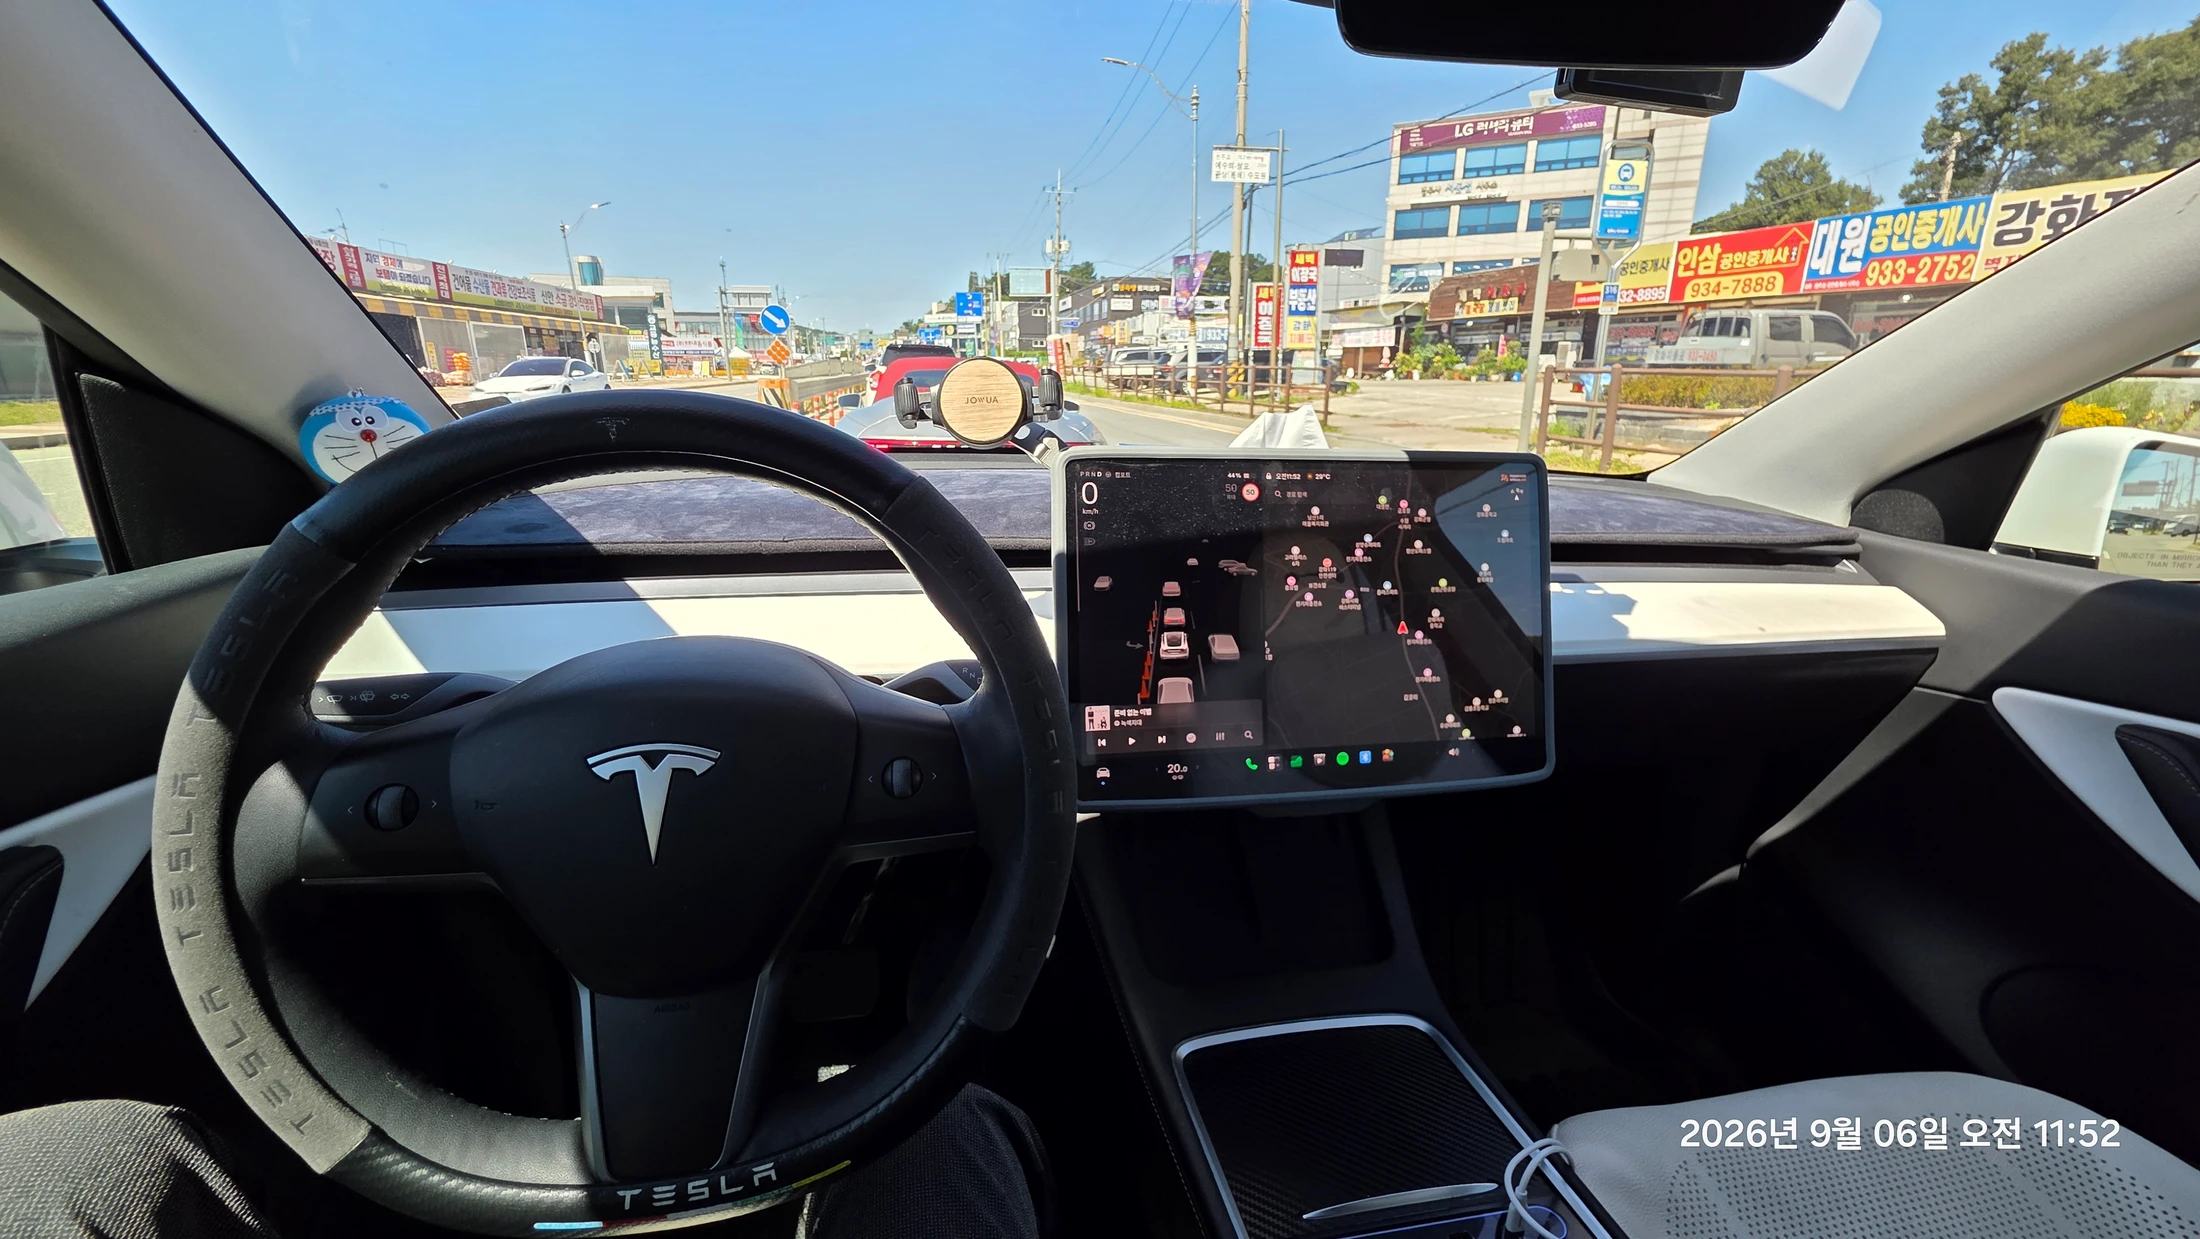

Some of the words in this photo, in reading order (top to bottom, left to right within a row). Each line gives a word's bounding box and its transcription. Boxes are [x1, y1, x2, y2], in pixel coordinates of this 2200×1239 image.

[1454, 124, 1475, 138] LG
[1993, 186, 2149, 246] 강화
[1809, 214, 1872, 276] 대원
[1868, 201, 1987, 254] 공인중개사
[1619, 257, 1670, 277] 공인중개사
[1677, 242, 1722, 278] 인삼
[1719, 245, 1790, 271] 공인중개사
[1865, 253, 1977, 287] 933-2752
[452, 273, 471, 291] 건어물
[472, 278, 490, 295] 수산물
[1619, 286, 1667, 304] 32-8895
[1690, 275, 1777, 298] 934-7888
[1288, 288, 1317, 311] 부동산
[964, 396, 999, 405] JOWUA
[1081, 481, 1099, 505] 0
[1225, 483, 1238, 493] 50
[1245, 488, 1256, 496] 50
[2117, 551, 2156, 560] OBJECTS
[2172, 554, 2200, 562] MIRRO
[1126, 708, 1139, 716] 없는
[1139, 707, 1152, 716] 이별
[1167, 764, 1188, 773] 20.0
[166, 772, 205, 953] TESLA
[199, 984, 315, 1138] TESLA
[616, 1161, 778, 1211] TESLA
